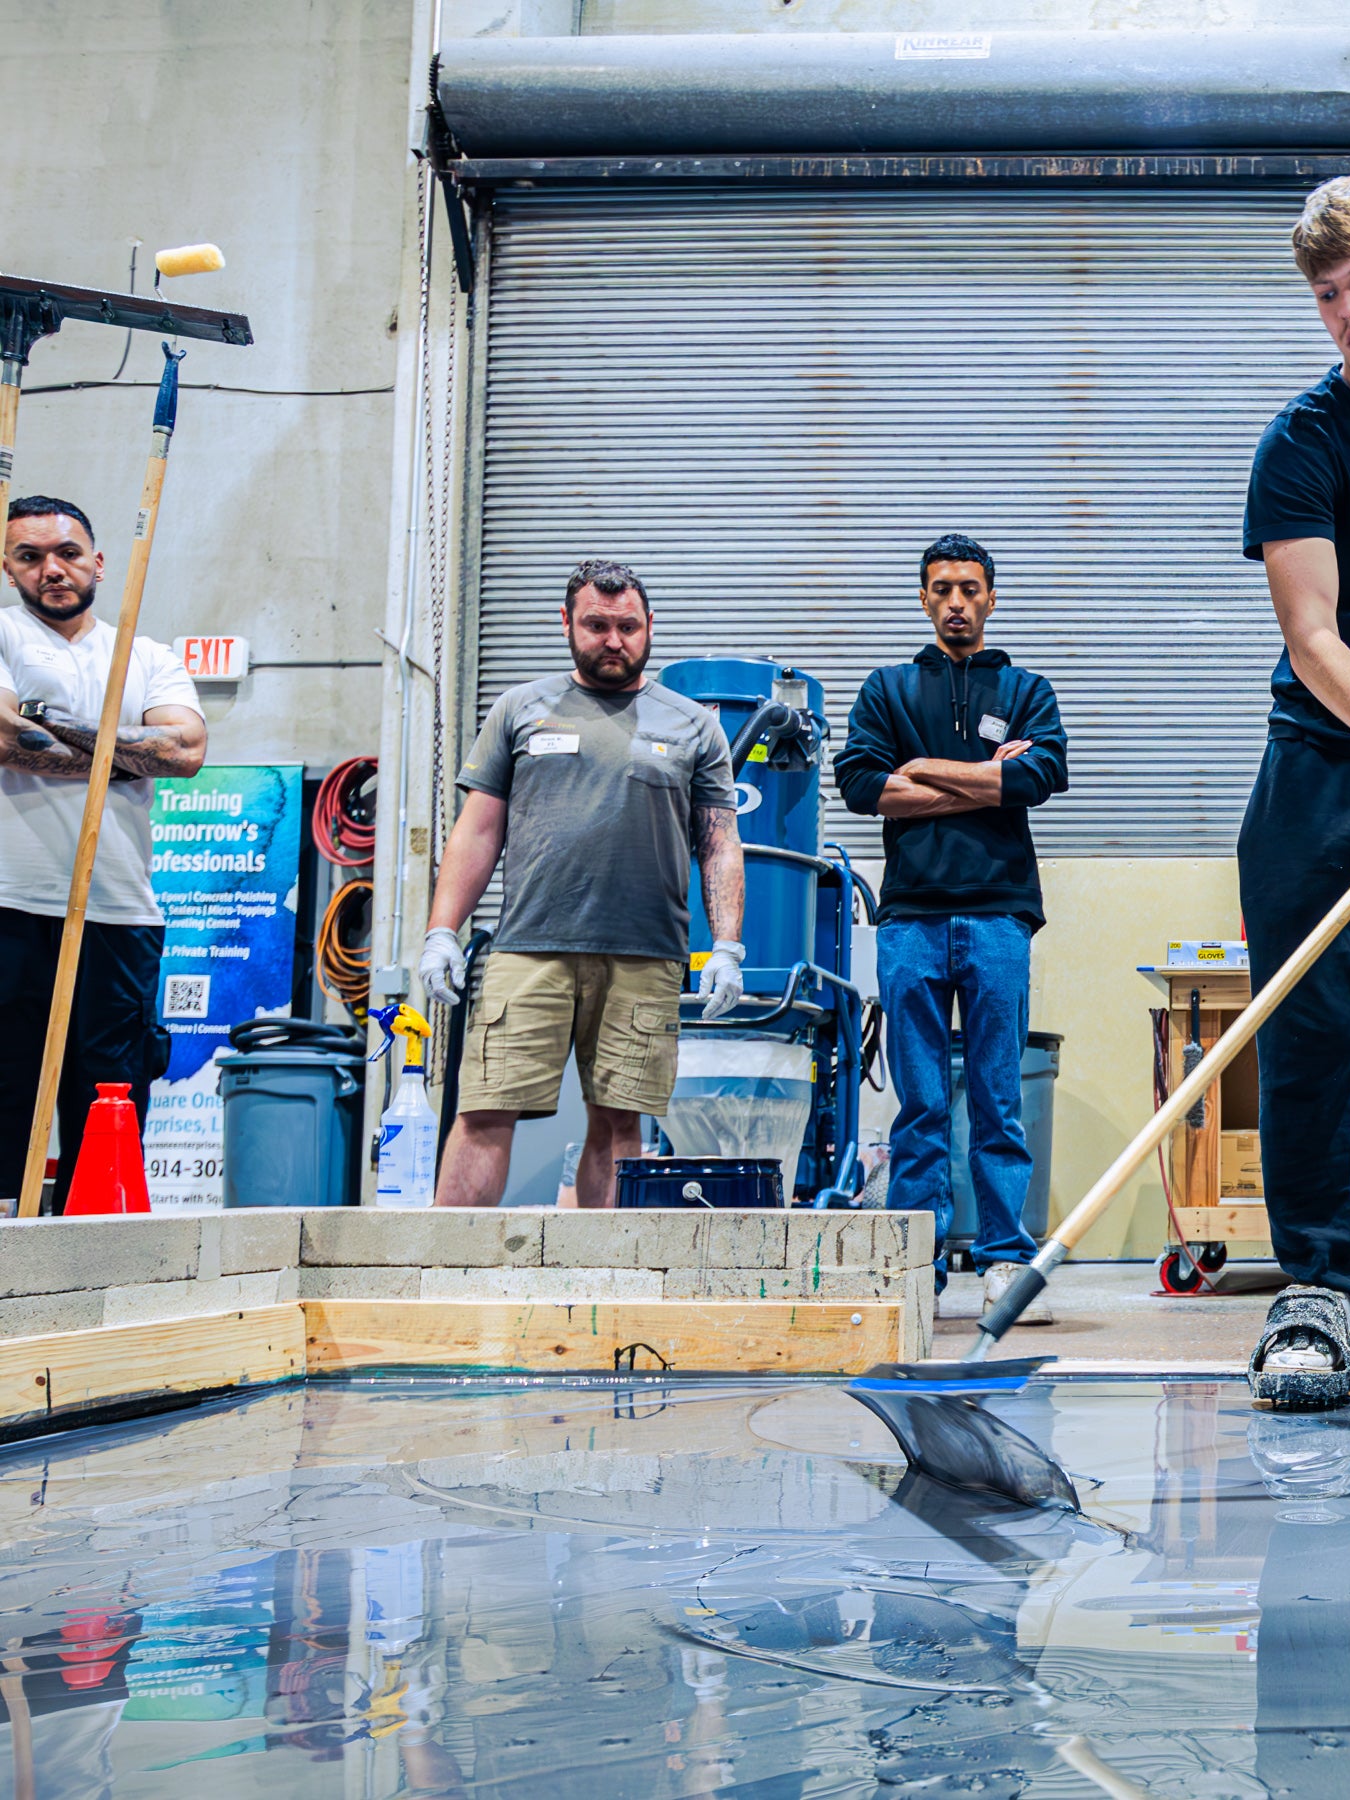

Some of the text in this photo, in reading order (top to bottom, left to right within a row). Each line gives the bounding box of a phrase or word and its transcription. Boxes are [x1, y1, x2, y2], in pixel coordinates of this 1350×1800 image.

[903, 36, 984, 51] KINNEAR
[184, 638, 234, 675] EXIT
[158, 789, 243, 816] Training
[150, 820, 259, 842] omorrow's
[152, 849, 266, 872] ofessionals
[193, 891, 233, 903] Concrete
[235, 890, 277, 905] Polishing
[206, 918, 241, 929] Cement
[172, 946, 208, 958] Private
[209, 945, 250, 960] Training
[198, 1024, 231, 1034] Connect
[147, 1116, 206, 1136] rprises,
[183, 1192, 204, 1204] with
